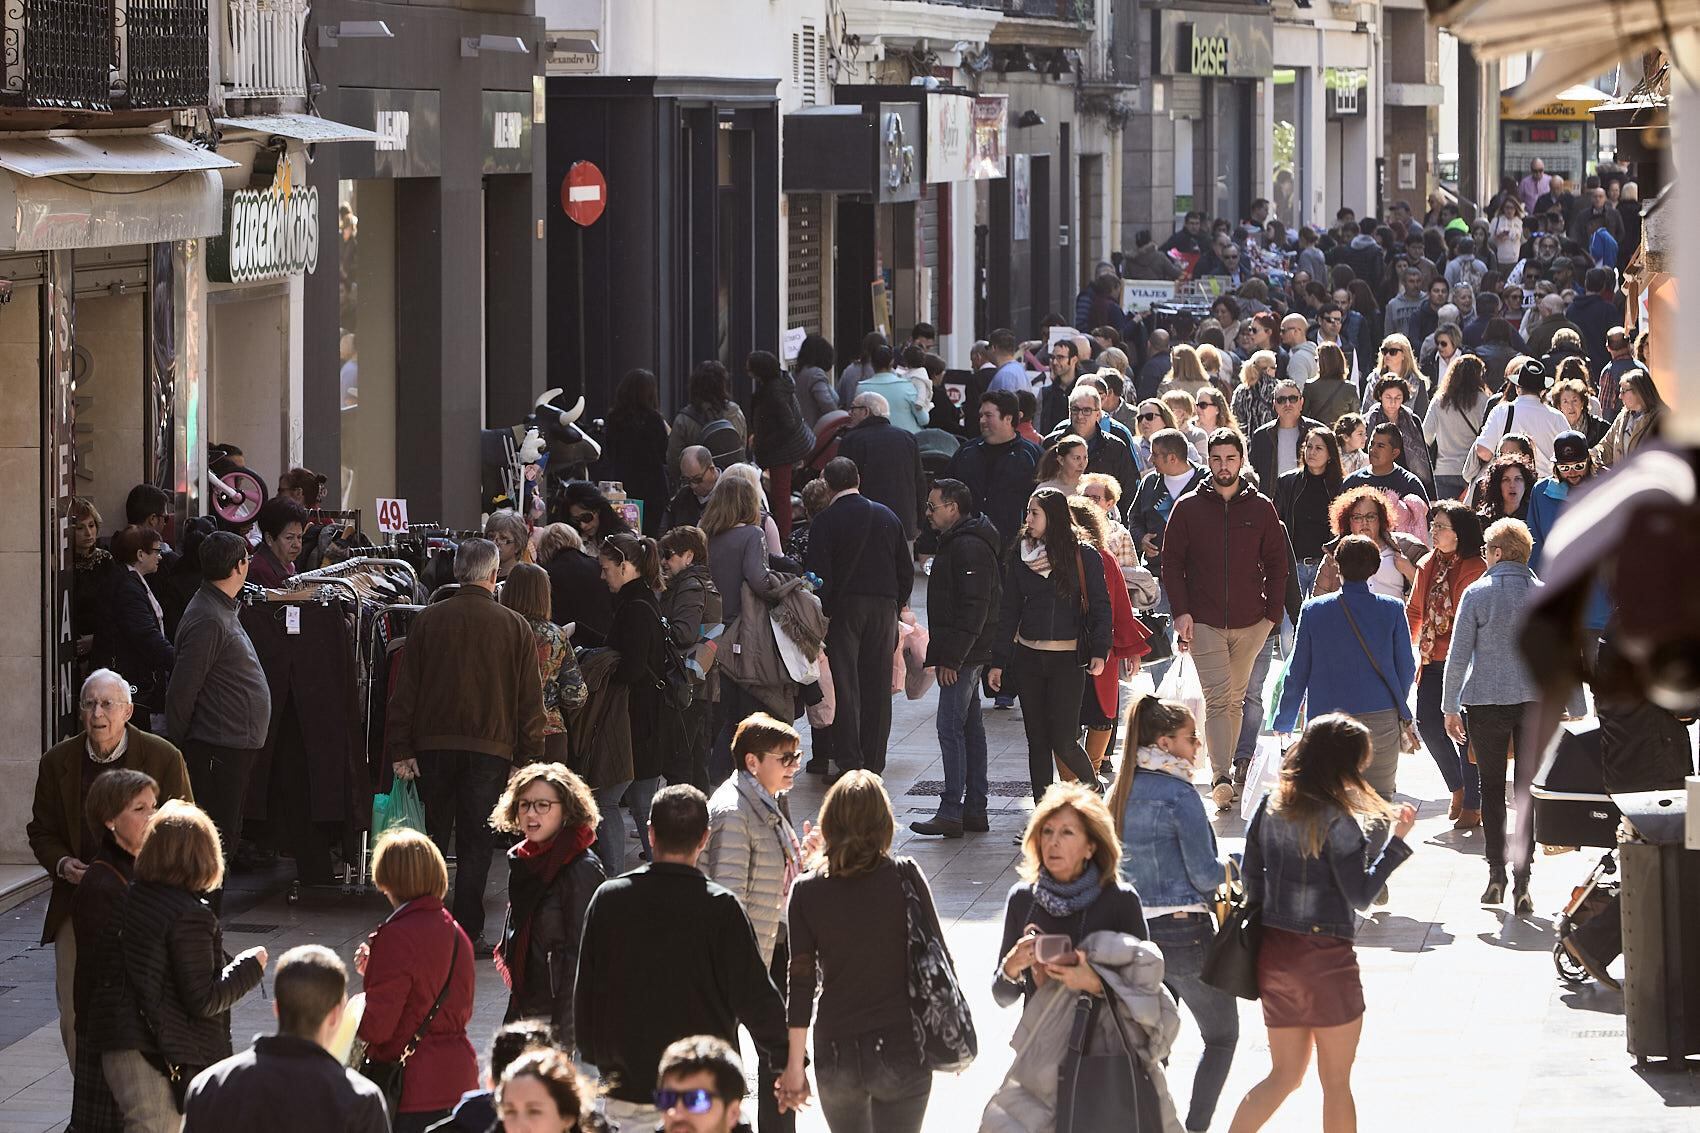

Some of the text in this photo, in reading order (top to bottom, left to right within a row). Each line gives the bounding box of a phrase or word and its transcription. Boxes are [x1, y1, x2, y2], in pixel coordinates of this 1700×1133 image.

[545, 53, 584, 64] lexandre
[1192, 22, 1226, 77] base
[1131, 289, 1168, 298] VIAJES
[58, 284, 73, 741] STEFAN
